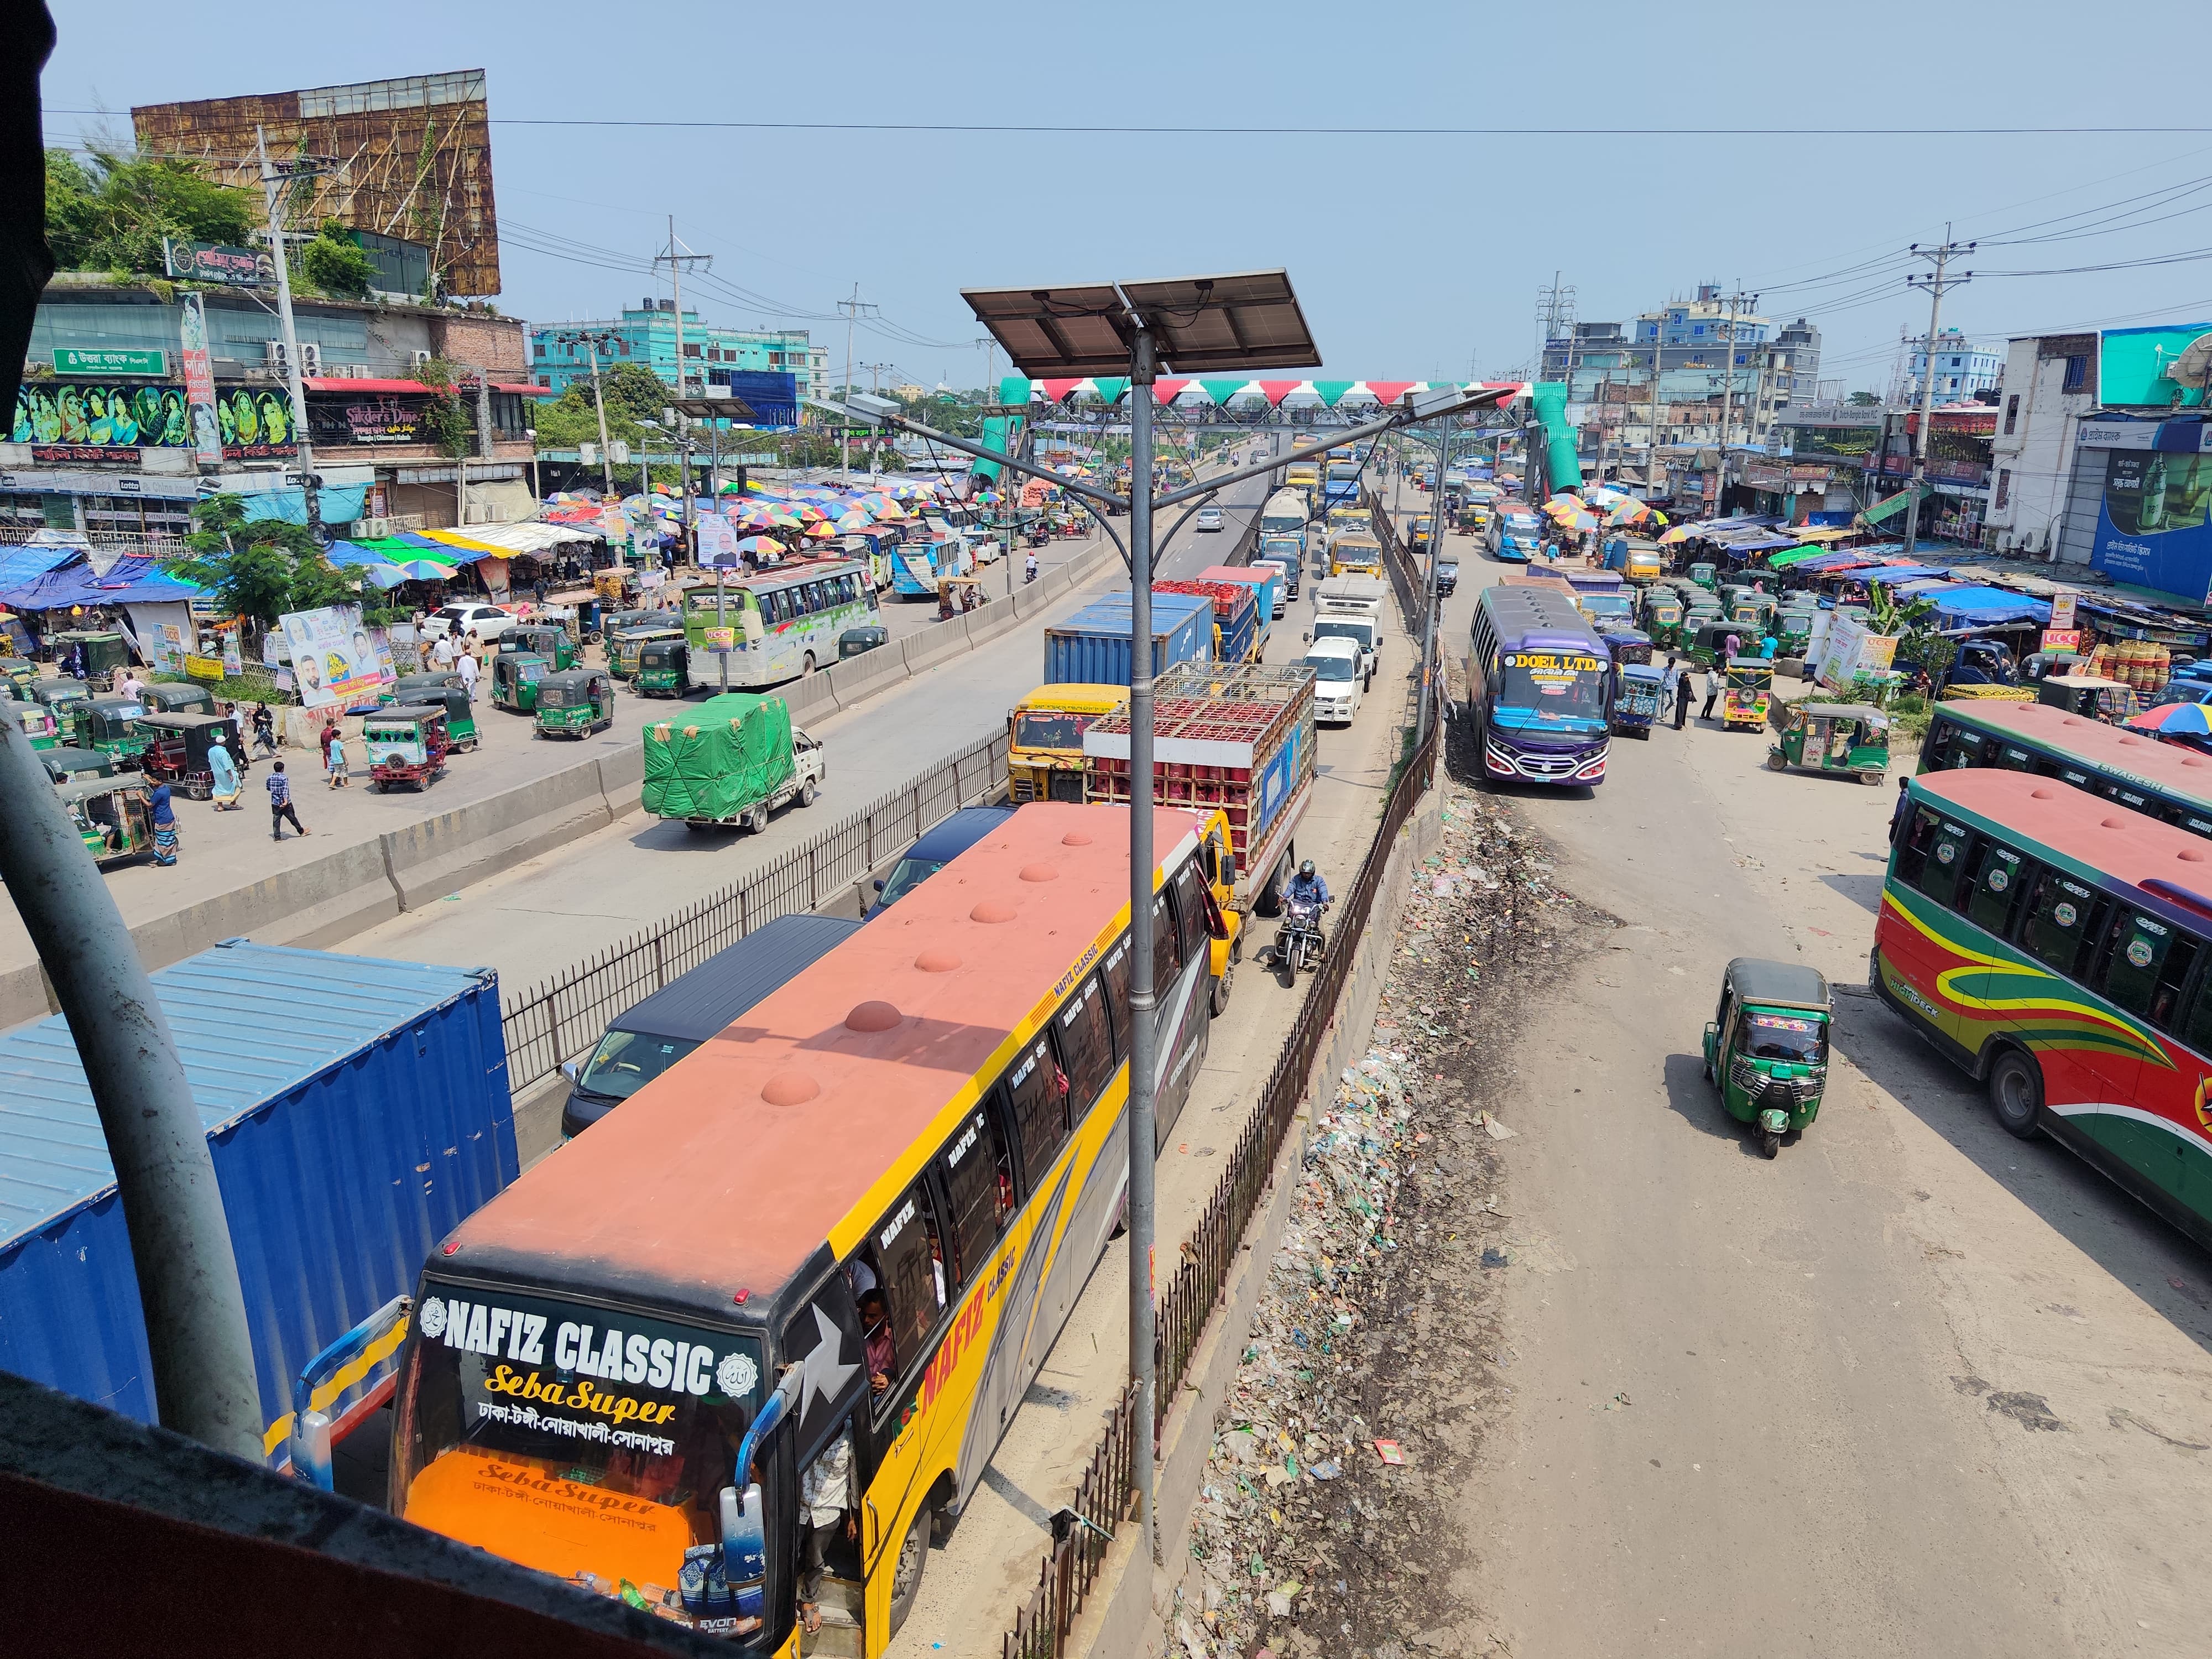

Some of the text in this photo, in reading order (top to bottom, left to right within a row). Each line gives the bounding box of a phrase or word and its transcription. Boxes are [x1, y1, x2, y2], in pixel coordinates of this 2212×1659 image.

[79, 352, 101, 364] উত্তরা
[104, 354, 127, 365] ব্যাংক
[189, 379, 208, 388] বিউটি
[191, 389, 209, 400] পার্লার
[346, 406, 421, 425] Sikder's Dine
[1839, 410, 1861, 421] Dutch-Bangla
[1861, 410, 1870, 419] Bank
[2103, 431, 2121, 441] ব্যাংক
[164, 630, 179, 640] UCC
[2047, 634, 2079, 643] UCC
[1515, 655, 1598, 672] DOEL LTD.
[2101, 764, 2162, 791] SWADESH
[1053, 943, 1098, 999] NAFIZ CLASSIC
[1107, 947, 1124, 972] NAFIZ
[1063, 997, 1084, 1027] NAFIZ
[1890, 980, 1912, 1000] HIGH
[1913, 995, 1940, 1019] DECK
[1012, 1055, 1036, 1089] NAFIZ
[948, 1126, 977, 1168] NAFIZ
[880, 1198, 915, 1250] NAFIZ
[921, 1245, 1016, 1417] NAFIZ CLASSIC
[444, 1299, 714, 1395] NAFIZ CLASSIC
[484, 1364, 676, 1425] Seba Super
[477, 1401, 675, 1455] ঢাকা-টঙ্গী-নোয়াখালী-সোনাপুর
[478, 1464, 655, 1515] Seba Super
[700, 1617, 737, 1630] EVON
